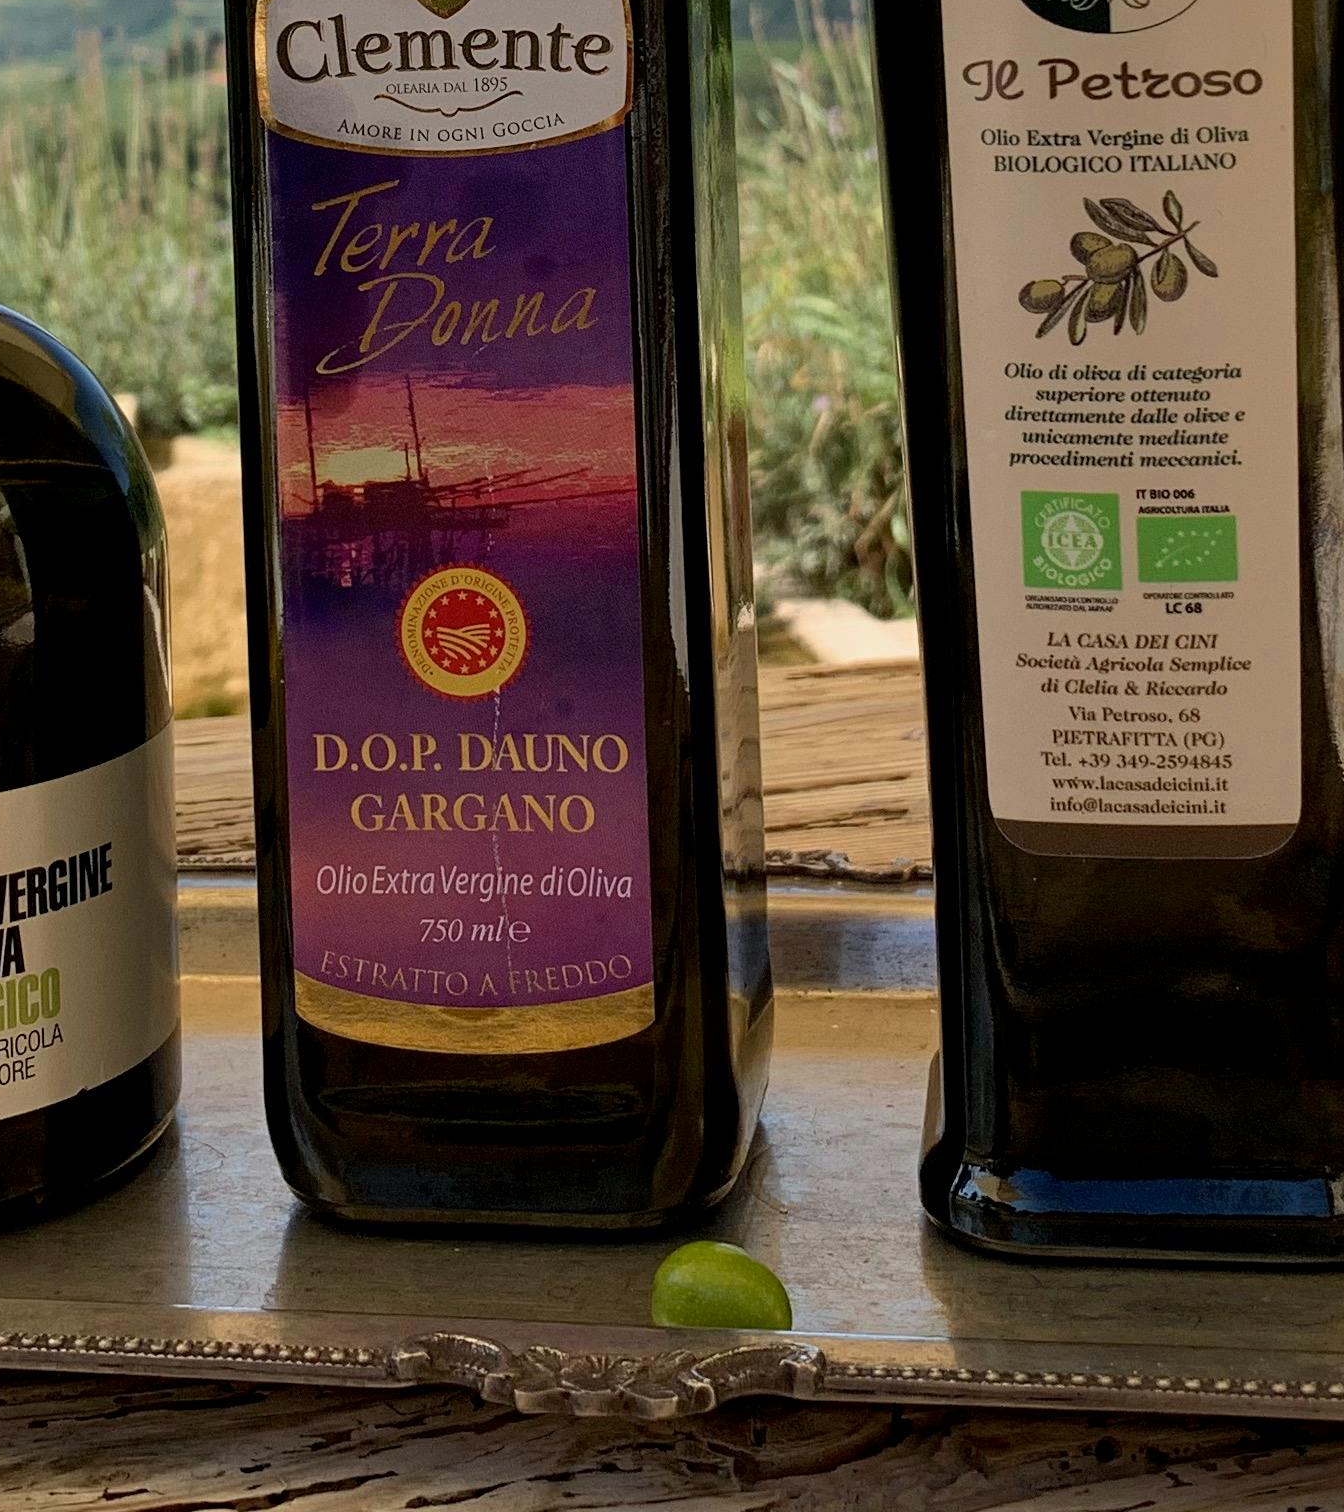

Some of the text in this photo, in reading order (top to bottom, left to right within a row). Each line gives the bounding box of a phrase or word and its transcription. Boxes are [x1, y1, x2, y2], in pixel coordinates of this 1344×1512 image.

[276, 13, 613, 83] Clemente
[386, 77, 508, 95] OLEARIA DAL 1895
[962, 57, 1264, 102] Il Petroso
[337, 113, 565, 142] AMORE IN OGNI GOCCIA
[981, 126, 1249, 150] Olio Extra Vergine di Oliva
[994, 152, 1237, 174] BIOLOGICO ITALIANO
[311, 179, 496, 276] Terra
[315, 272, 600, 374] Donna
[1004, 362, 1242, 383] Olio di oliva di categoria
[1035, 387, 1211, 405] superiore ottenuto
[1004, 406, 1245, 424] direttamente dalle olive e
[1022, 429, 1229, 445] unicamente mediante
[1009, 450, 1242, 467] procedimenti meccanici.
[1136, 489, 1195, 499] IT BIO 006
[1034, 496, 1111, 528] CERTIFICATO
[1138, 505, 1230, 514] AGRICOLTURA ITALIA
[1047, 532, 1097, 548] ICEA
[1033, 555, 1112, 587] BIOLOGICO
[1165, 602, 1203, 614] LC 68
[408, 575, 519, 674] DENOMINAZIONE D'ORIGINE PROTETTA
[1047, 632, 1218, 649] LA CASA DEI CINI
[1016, 653, 1252, 674] Società Agricola Semplice
[1041, 678, 1227, 696] di Clelia & Riccardo
[1068, 705, 1096, 722] Via
[1178, 708, 1201, 722] 68
[1052, 729, 1225, 750] PIETRAFITTA (PG)
[313, 733, 629, 773] D.O.P. DAUNO
[1040, 751, 1232, 769] Tel. +39 349-2594845
[1052, 776, 1228, 792] www.lacasadeicini.it
[350, 793, 596, 833] GARGANO
[1050, 797, 1226, 815] info@lacasadeicini.it
[316, 865, 633, 902] Olio Extra Vergine di Oliva
[419, 918, 463, 942] 750
[320, 950, 632, 996] ESTRATTO A FREDDO
